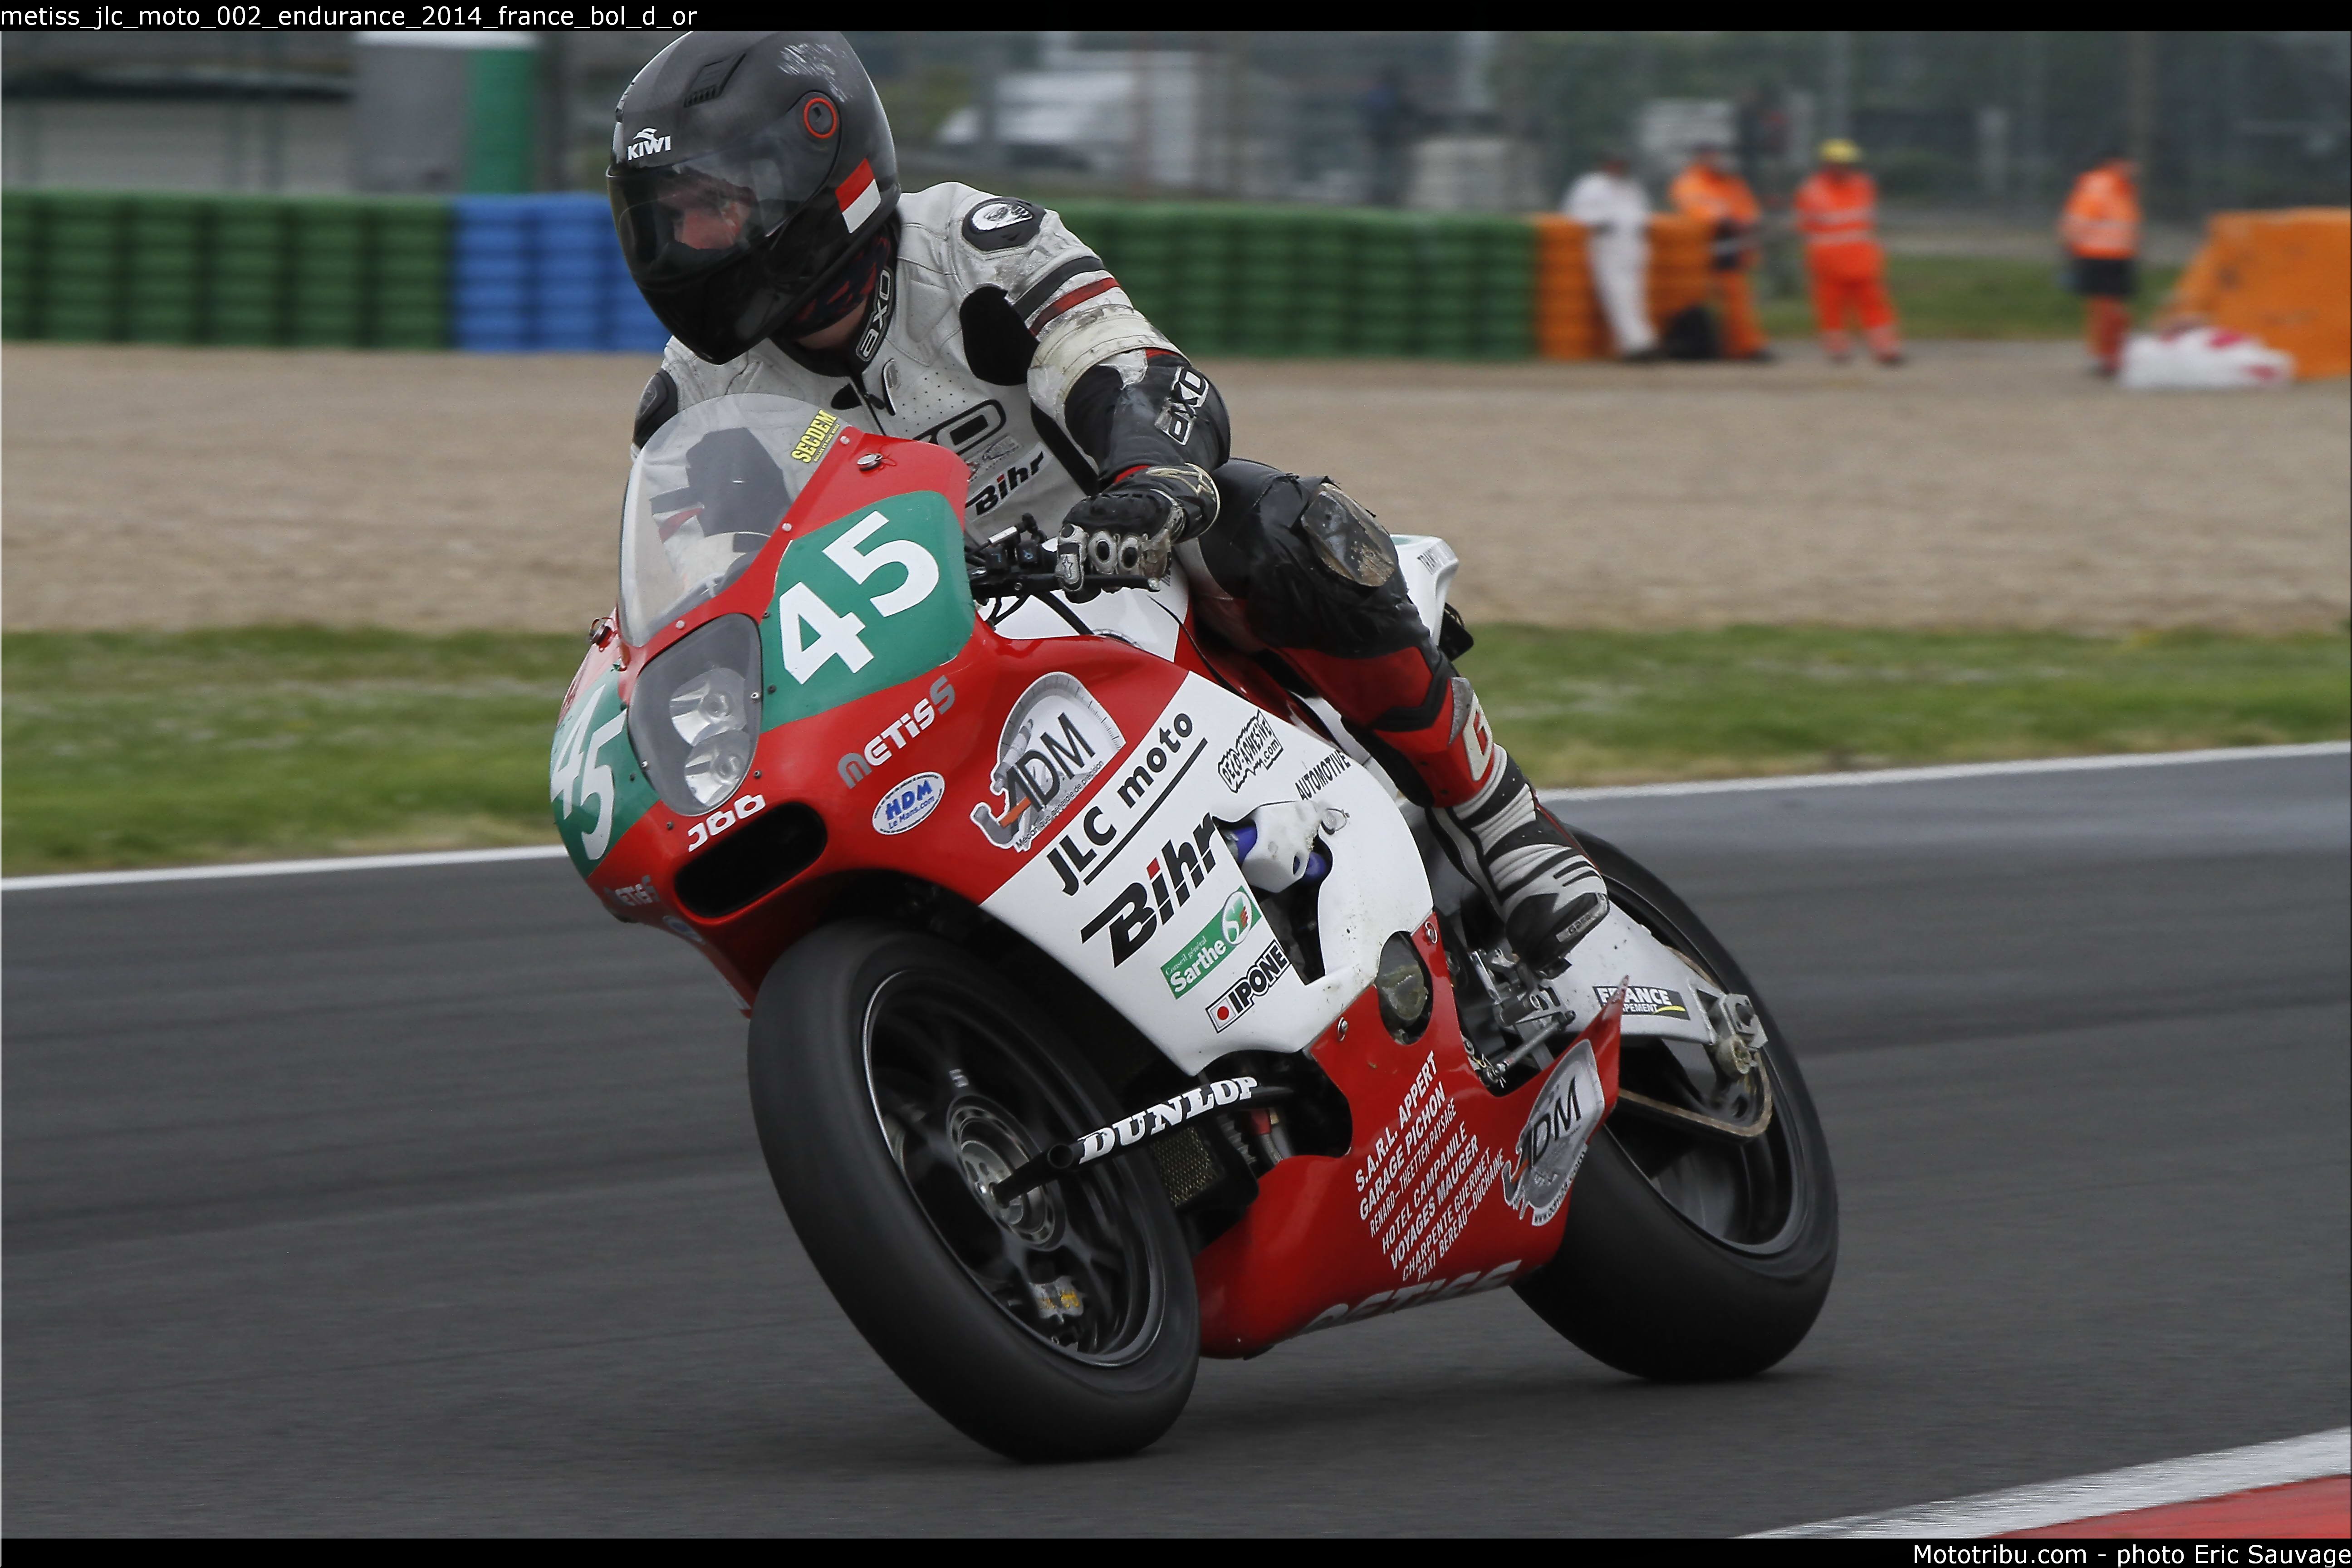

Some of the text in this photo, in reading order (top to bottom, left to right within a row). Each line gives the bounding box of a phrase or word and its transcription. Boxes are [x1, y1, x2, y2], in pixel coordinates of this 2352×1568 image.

[628, 136, 671, 161] KIWI
[791, 409, 838, 463] SECDEM
[965, 451, 1044, 515] Bihr
[779, 510, 940, 684] 45
[550, 684, 627, 860] 45
[886, 779, 932, 820] HDM
[1046, 713, 1192, 896] JLC moto
[1295, 750, 1351, 800] AUTOMOTIVE
[1081, 812, 1216, 968] Bihr
[1170, 940, 1226, 992] Sarthe
[1228, 944, 1288, 1014] IPONE
[1078, 1077, 1258, 1164] DUNLOP
[1356, 1050, 1437, 1192] S.A.R.L. APPERT
[1360, 1081, 1445, 1220] GARAGE PICHON
[1430, 1098, 1456, 1150] PAYSAGE
[1382, 1120, 1467, 1255] HOTEL CAMPANILE
[1391, 1134, 1479, 1270] VOYAGES MAUGER
[1402, 1147, 1490, 1282] CHARPENTE GUERINET
[1417, 1250, 1436, 1282] TAXI
